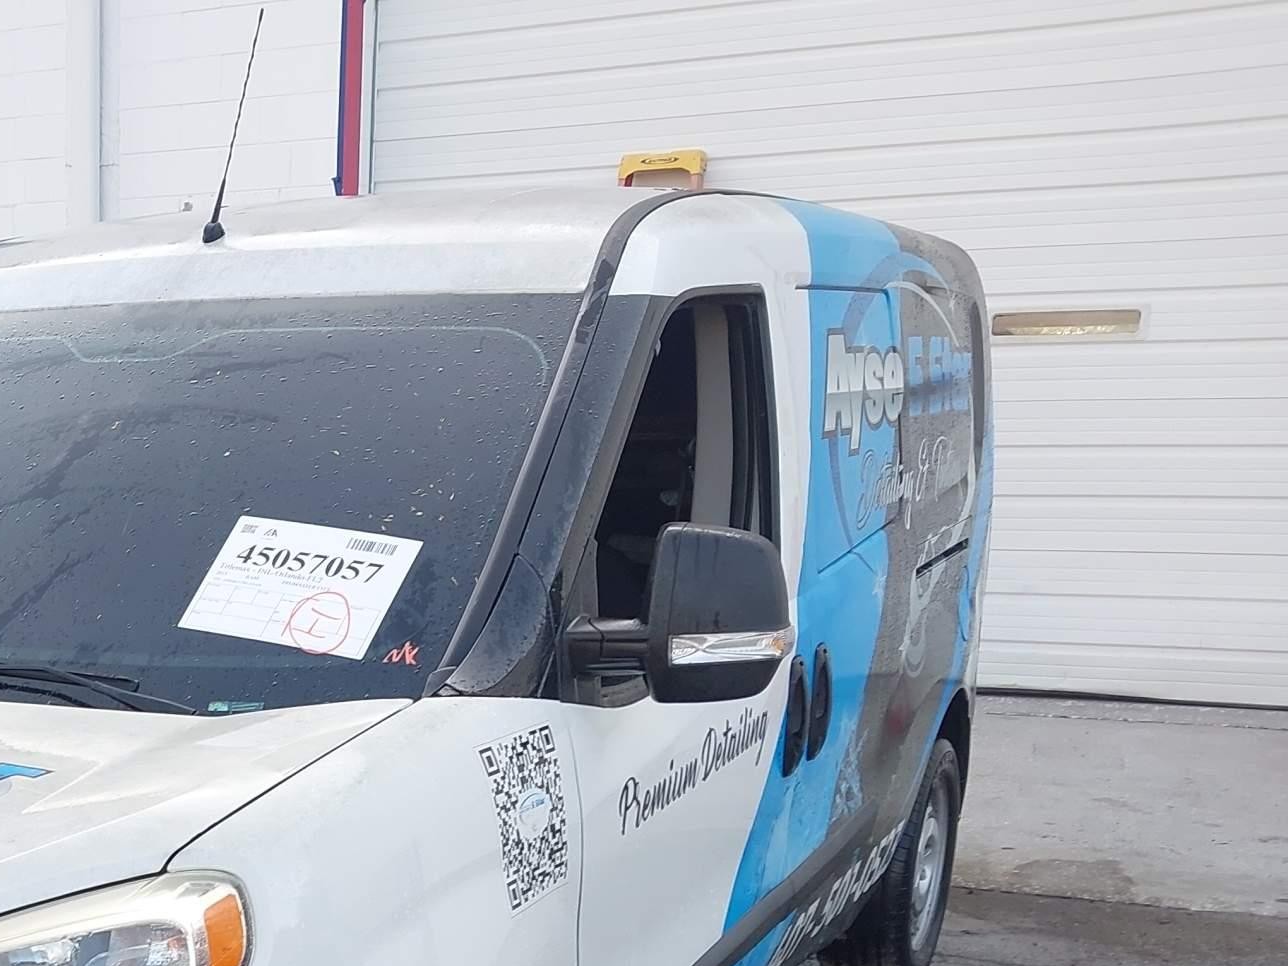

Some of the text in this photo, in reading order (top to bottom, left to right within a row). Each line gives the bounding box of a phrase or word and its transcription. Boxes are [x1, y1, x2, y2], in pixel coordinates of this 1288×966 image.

[821, 328, 905, 456] Ayse
[236, 544, 384, 584] 45057057
[619, 706, 768, 836] Premium Detailing
